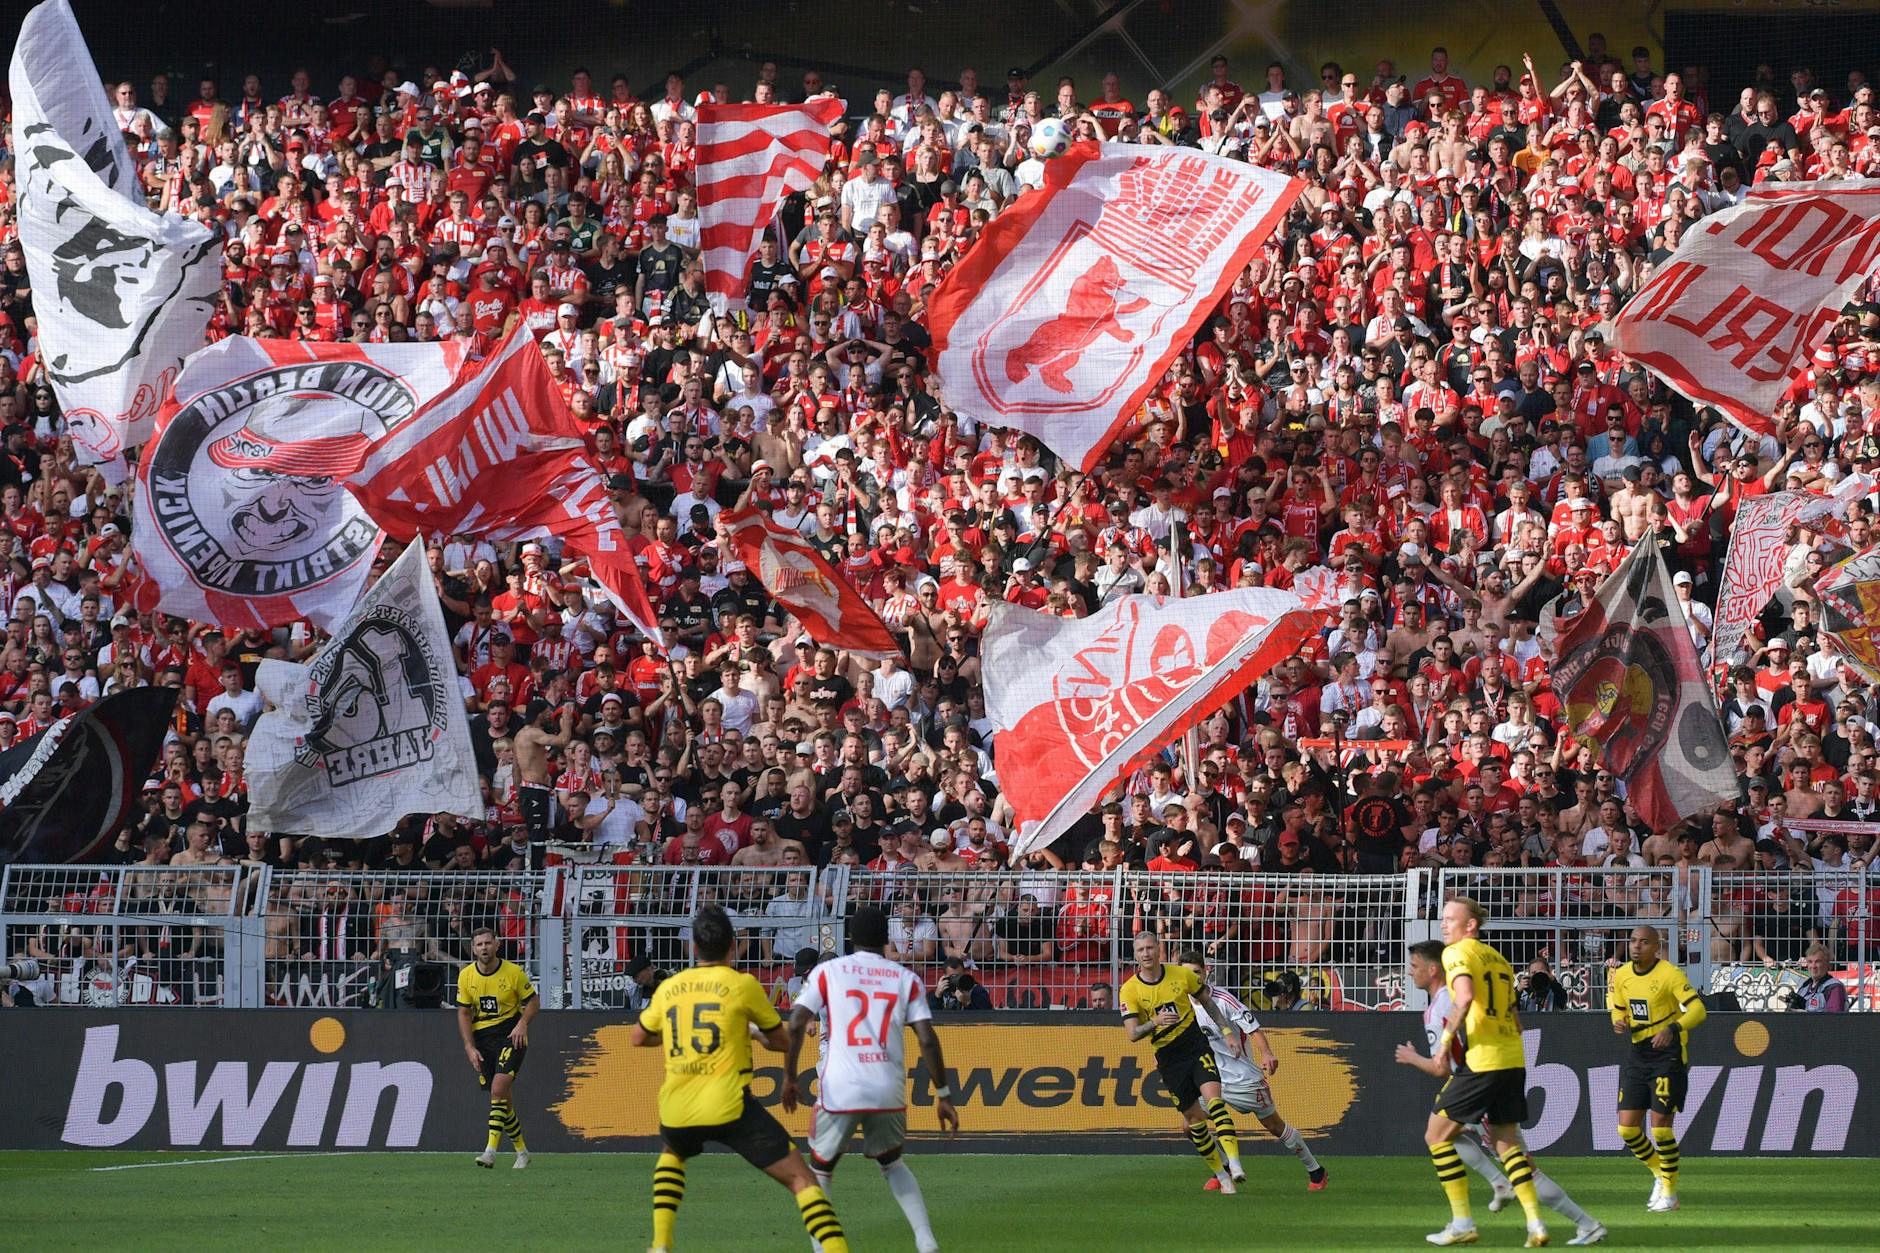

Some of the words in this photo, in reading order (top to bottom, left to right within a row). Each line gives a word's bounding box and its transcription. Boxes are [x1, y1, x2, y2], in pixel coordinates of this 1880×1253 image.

[852, 965, 863, 975] FC
[867, 967, 899, 978] UNION
[859, 978, 881, 986] BERLIN
[664, 981, 731, 1001] DORTMUND
[1630, 1002, 1648, 1016] 1&1
[845, 989, 899, 1049] 27
[666, 1003, 723, 1058] 15
[499, 1047, 513, 1061] 14
[858, 1051, 889, 1063] BECKE
[1199, 1053, 1215, 1068] 11
[60, 1017, 434, 1147] bwin
[1518, 1020, 1860, 1151] bwin
[1655, 1077, 1670, 1096] 21
